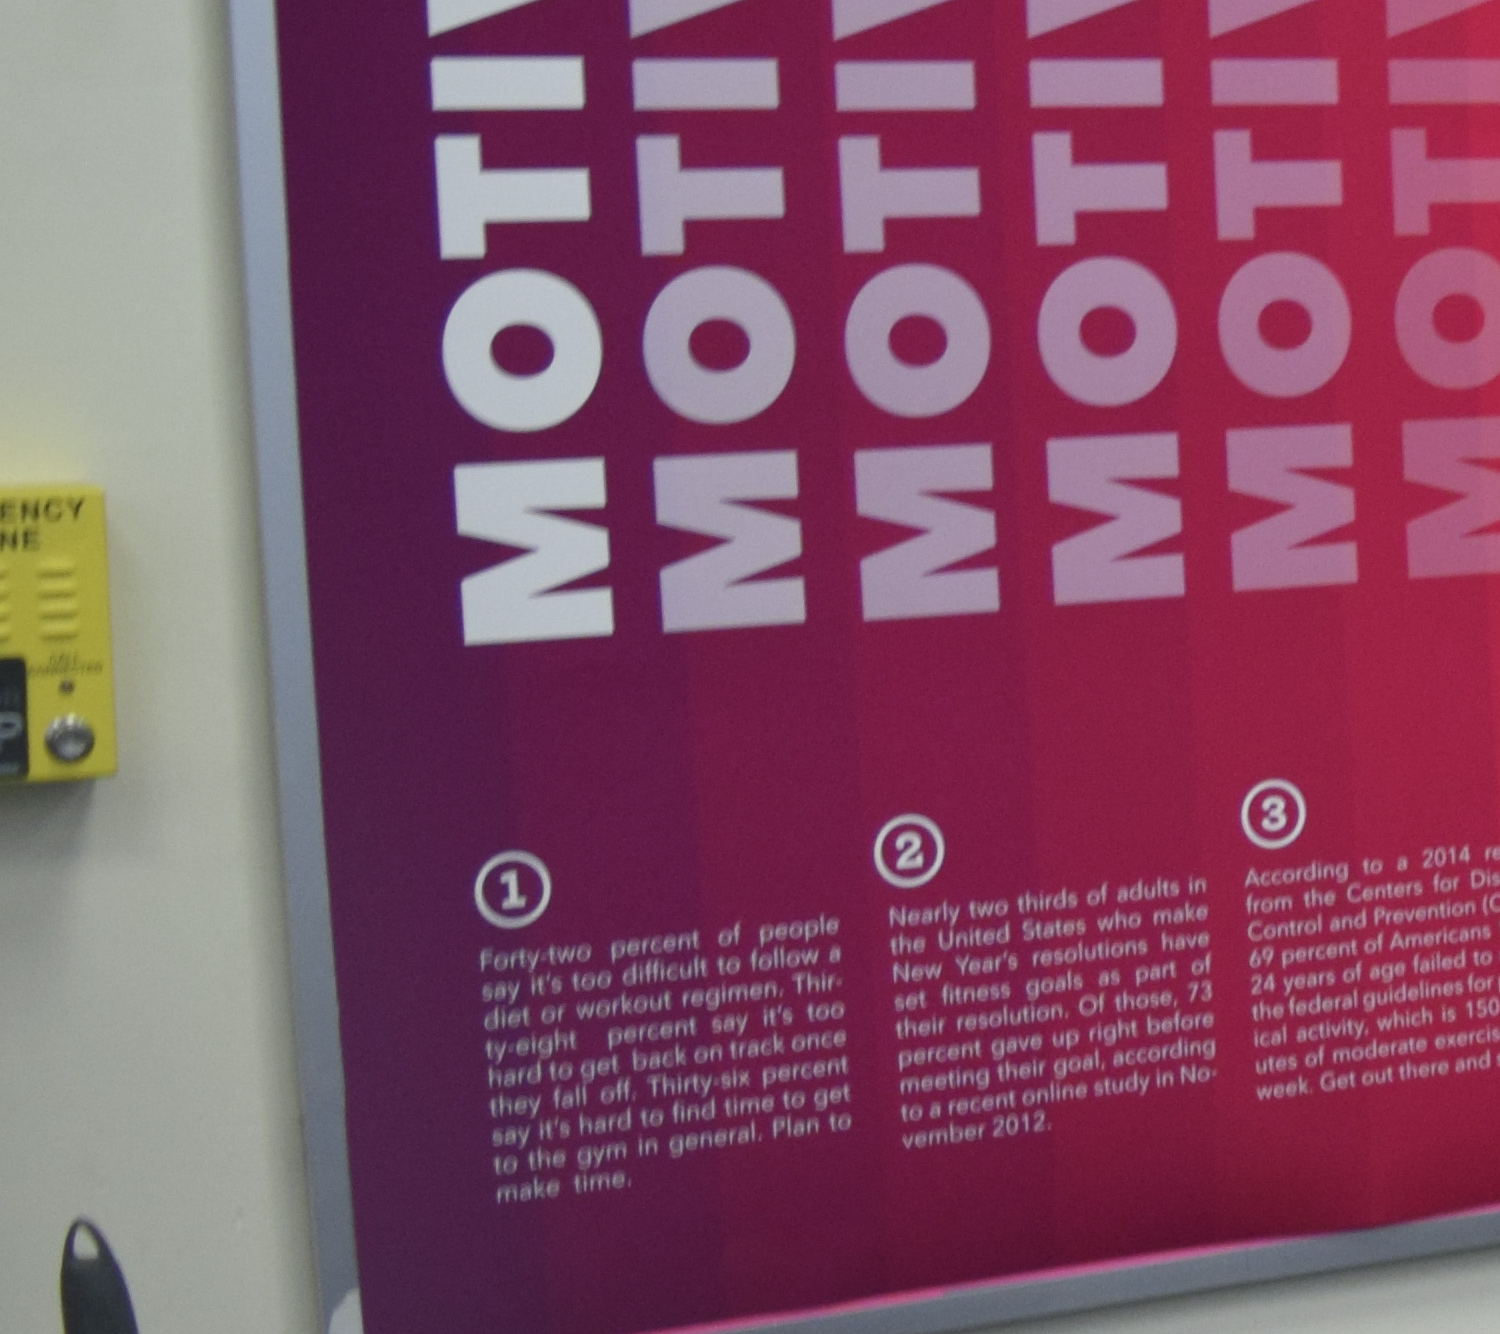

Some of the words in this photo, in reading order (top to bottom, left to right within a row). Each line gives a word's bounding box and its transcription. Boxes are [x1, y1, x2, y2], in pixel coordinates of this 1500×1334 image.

[0, 497, 86, 524] ENCY
[0, 530, 41, 552] NE
[1244, 860, 1349, 888] According
[1361, 857, 1384, 875] to
[1396, 855, 1409, 872] a
[1422, 843, 1471, 869] 2014
[888, 899, 960, 928] Nearly
[968, 900, 1009, 919] two
[1016, 887, 1077, 913] thirds
[1086, 882, 1107, 906] of
[1116, 877, 1180, 903] adults
[1188, 876, 1207, 895] in
[1245, 892, 1293, 915] from
[1302, 887, 1336, 909] the
[1345, 880, 1423, 904] Centers
[1432, 872, 1460, 893] for
[479, 944, 592, 972] Forty-two
[610, 928, 699, 964] percent
[717, 921, 741, 947] of
[758, 914, 840, 948] people
[889, 932, 926, 956] the
[937, 920, 1011, 951] United
[1021, 918, 1087, 941] States
[1096, 908, 1142, 932] who
[1152, 901, 1209, 926] make
[1246, 912, 1322, 942] Control
[1329, 907, 1367, 932] and
[1373, 899, 1476, 927] Prevention
[1248, 945, 1274, 969] 69
[1280, 938, 1357, 968] percent
[1363, 931, 1383, 954] of
[1389, 924, 1491, 951] Americans
[481, 981, 520, 1002] say
[530, 971, 562, 996] it's
[571, 971, 612, 992] too
[622, 954, 707, 986] difficult
[716, 955, 741, 976] to
[749, 946, 819, 972] follow
[828, 945, 841, 964] a
[891, 961, 943, 984] New
[954, 949, 1019, 976] Year's
[1031, 938, 1148, 968] resolutions
[1160, 931, 1210, 951] have
[893, 989, 926, 1012] set
[940, 982, 1011, 1006] fitness
[1025, 969, 1084, 1001] goals
[1097, 968, 1121, 987] as
[1134, 960, 1177, 988] part
[1190, 952, 1212, 976] of
[483, 1005, 529, 1030] diet
[540, 1004, 564, 1024] or
[575, 989, 671, 1020] workout
[681, 980, 783, 1011] regimen.
[793, 972, 842, 995] Thir-
[894, 1016, 945, 1040] their
[955, 1003, 1069, 1032] resolution.
[1077, 991, 1105, 1017] Of
[1113, 990, 1178, 1013] those,
[1188, 979, 1213, 1003] 73
[484, 1028, 576, 1063] ty-eight
[607, 1015, 696, 1051] percent
[711, 1012, 748, 1036] say
[762, 1007, 793, 1028] it's
[806, 1002, 845, 1022] too
